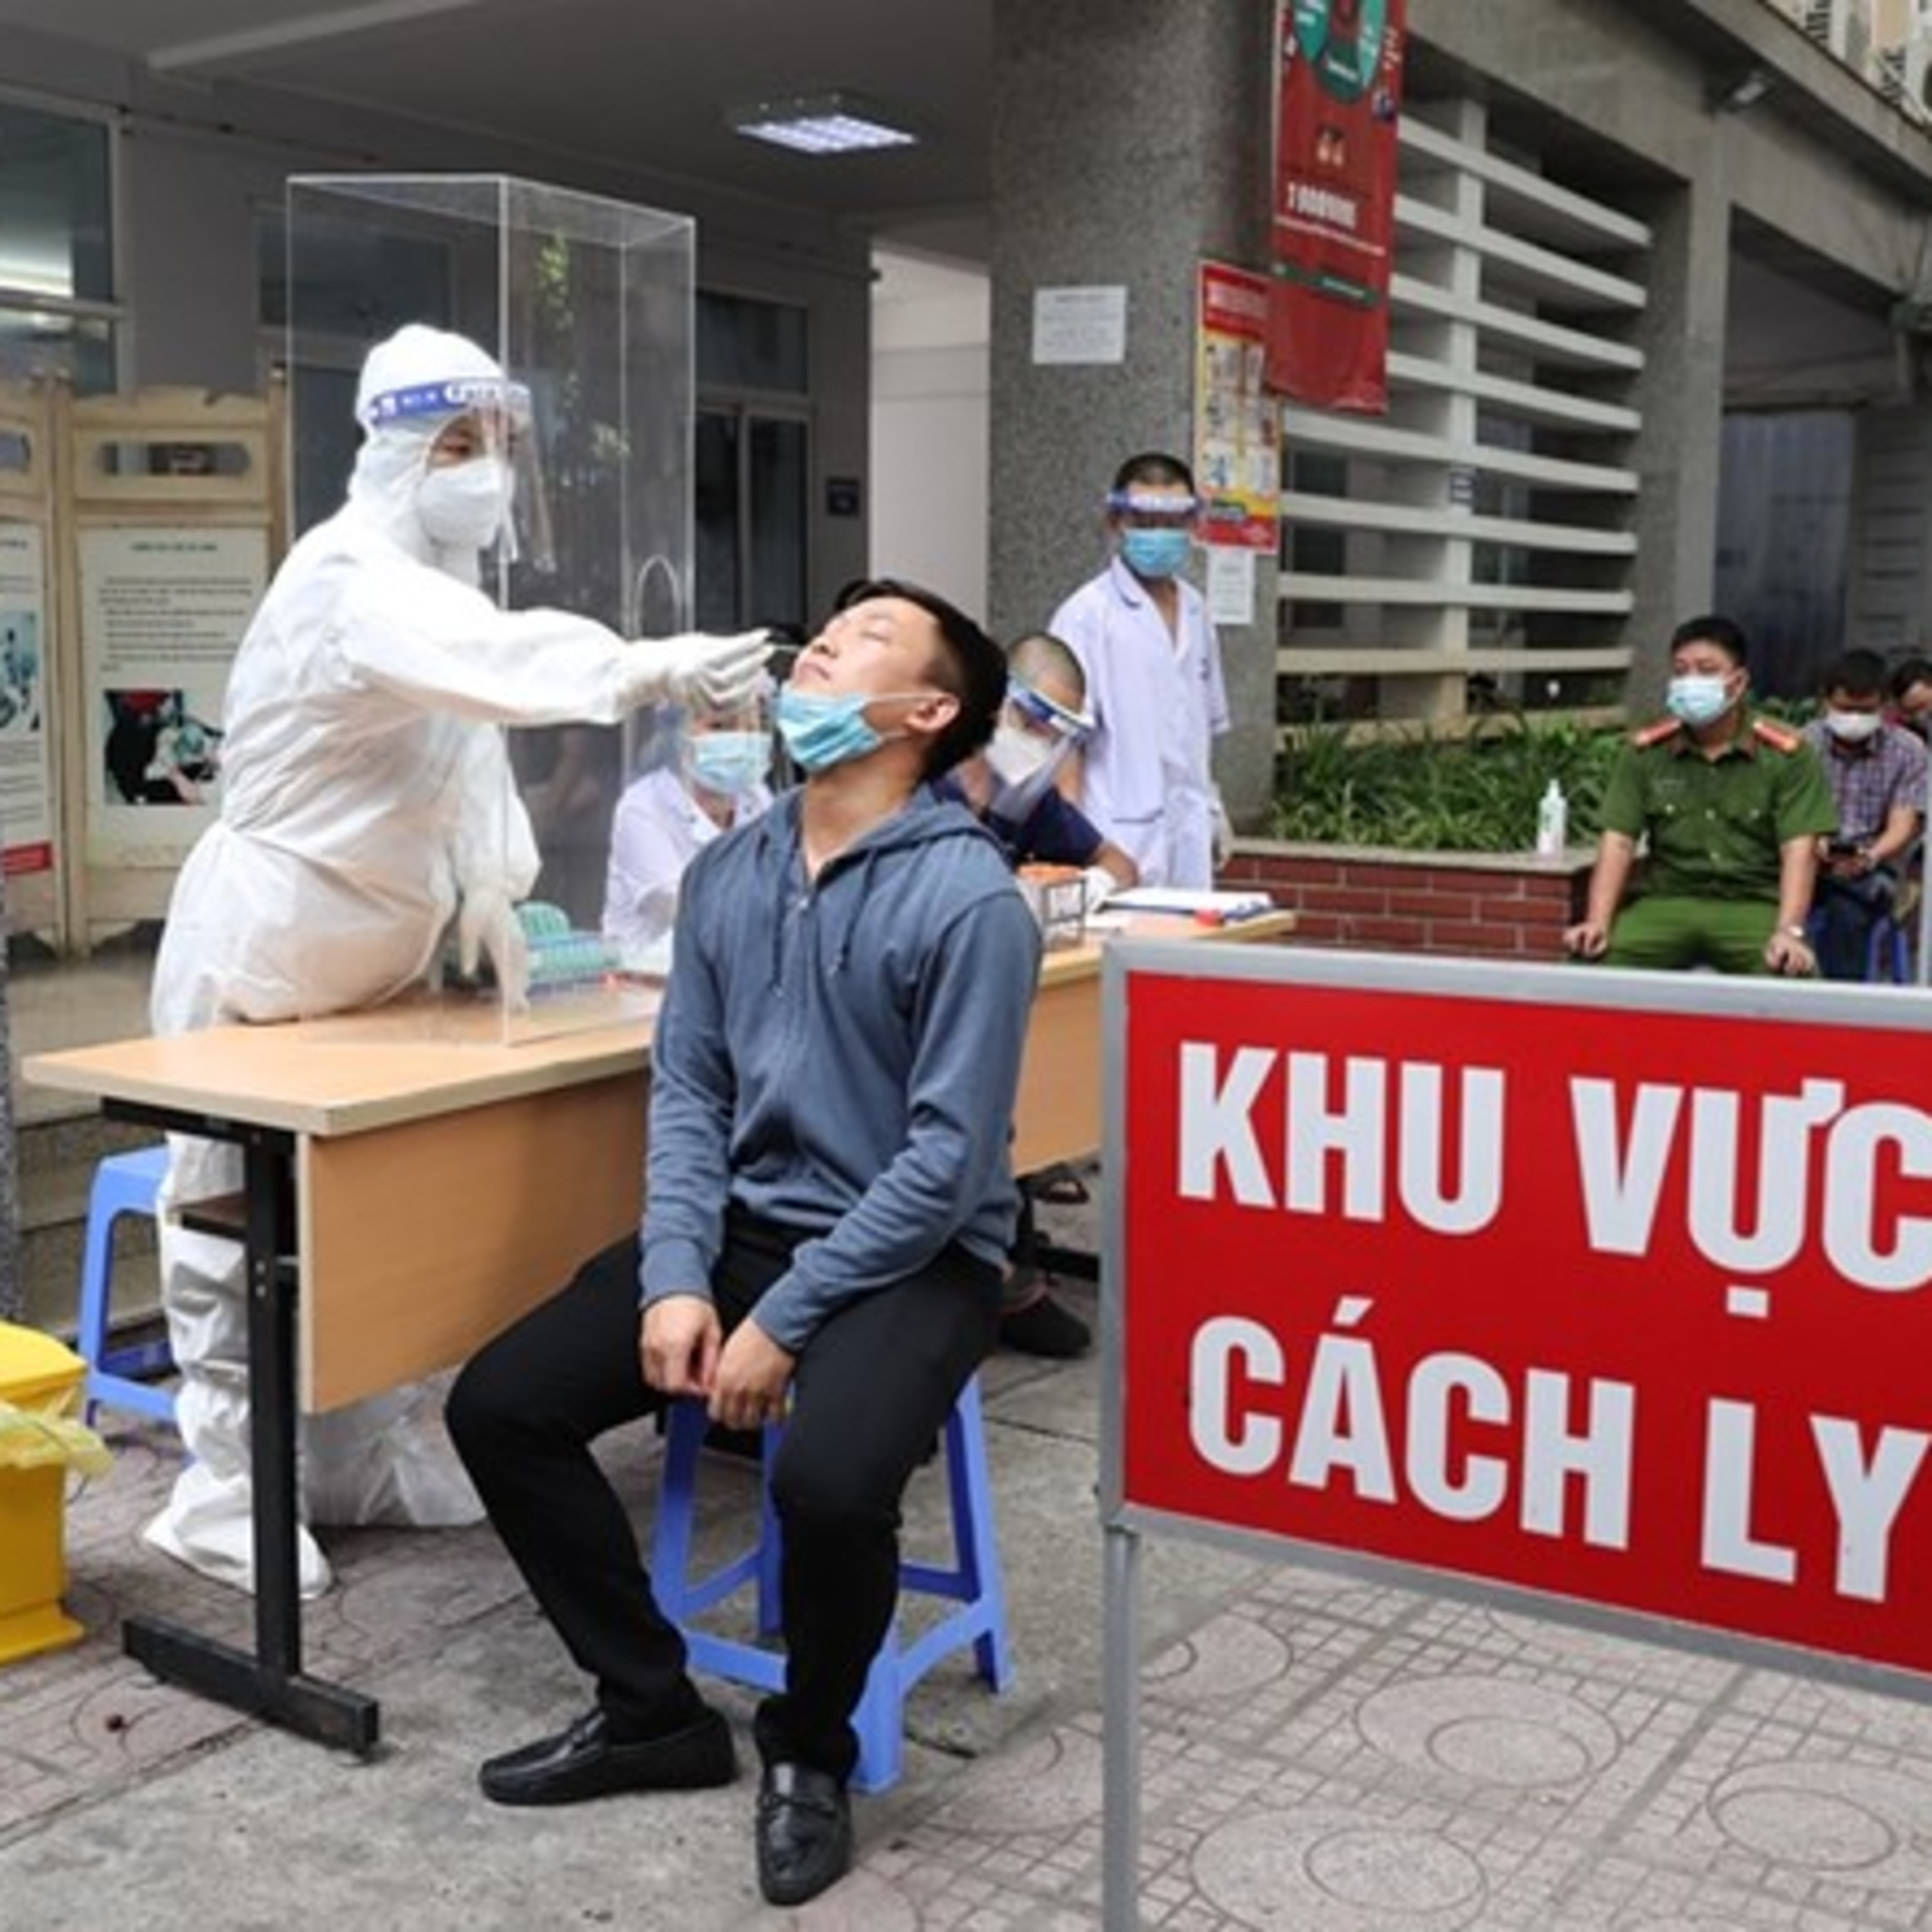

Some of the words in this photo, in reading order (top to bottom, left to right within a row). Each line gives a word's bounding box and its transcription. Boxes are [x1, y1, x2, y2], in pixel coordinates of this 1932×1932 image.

[1179, 1041, 1506, 1235] KHU
[1569, 1077, 1932, 1318] VỰC
[1188, 1296, 1636, 1550] CÁCH
[1701, 1397, 1932, 1602] LY
